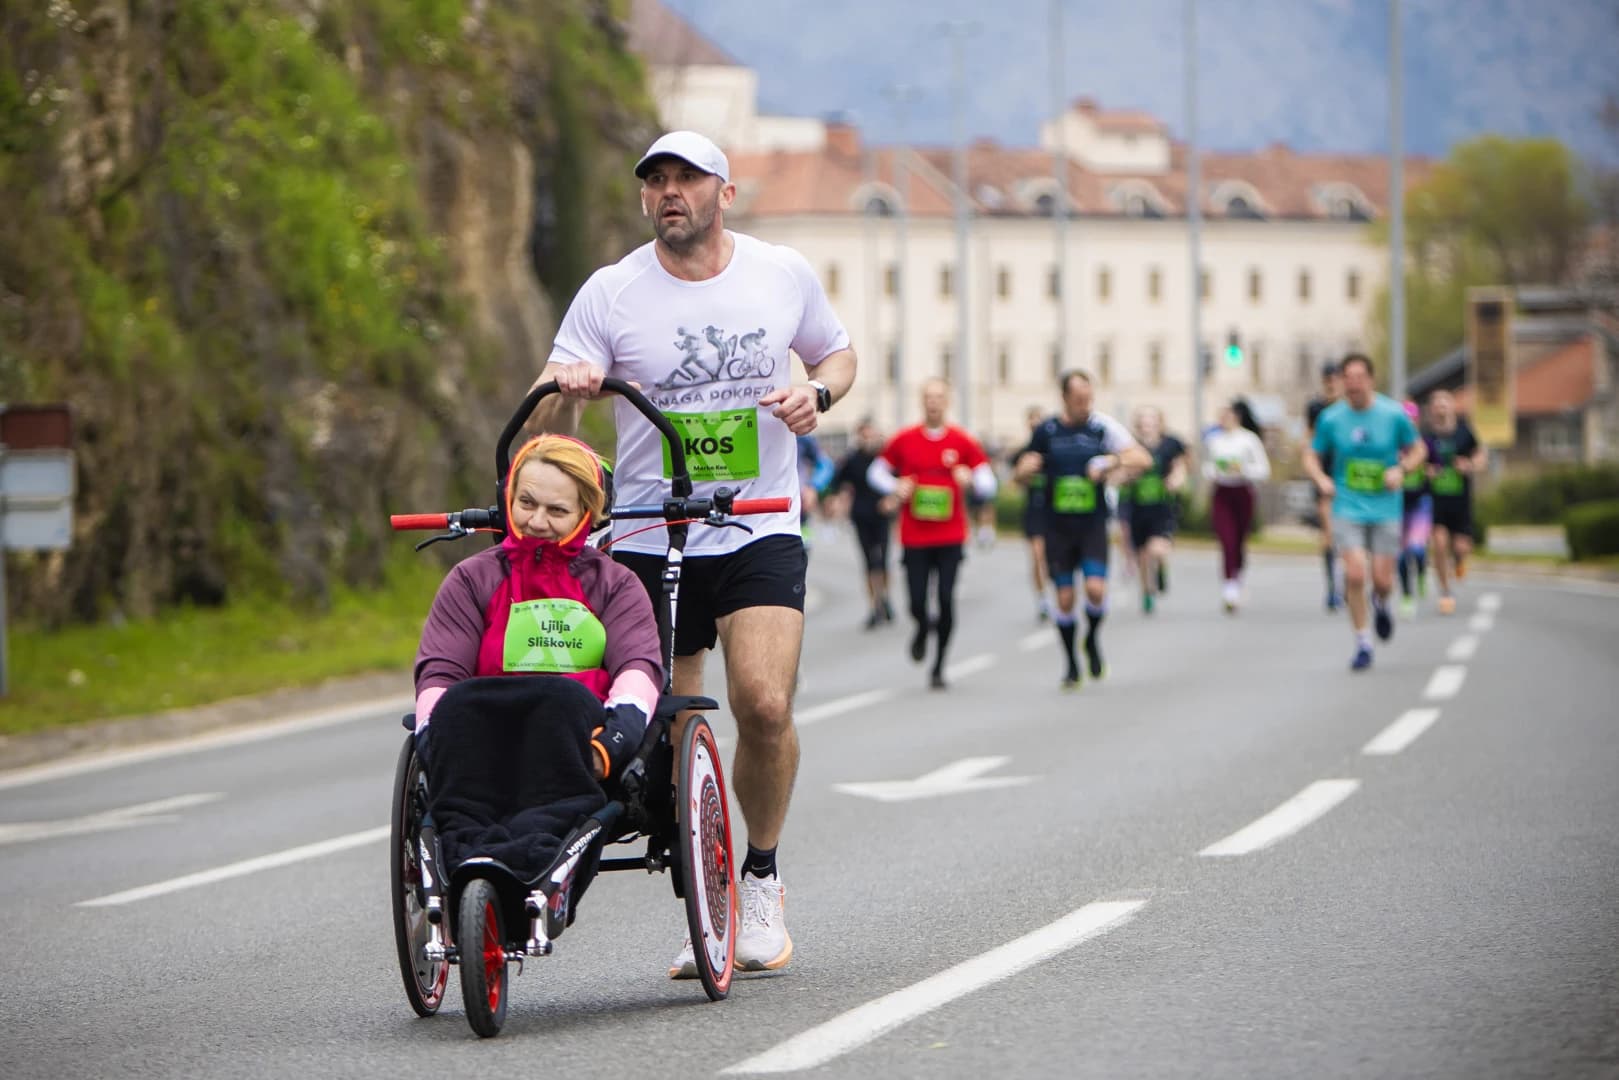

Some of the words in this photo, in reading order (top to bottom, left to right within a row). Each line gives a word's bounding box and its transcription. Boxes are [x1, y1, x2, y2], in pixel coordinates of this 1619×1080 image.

[684, 436, 734, 456] KOS
[541, 620, 571, 633] Ljilja
[527, 637, 583, 649] Slišković
